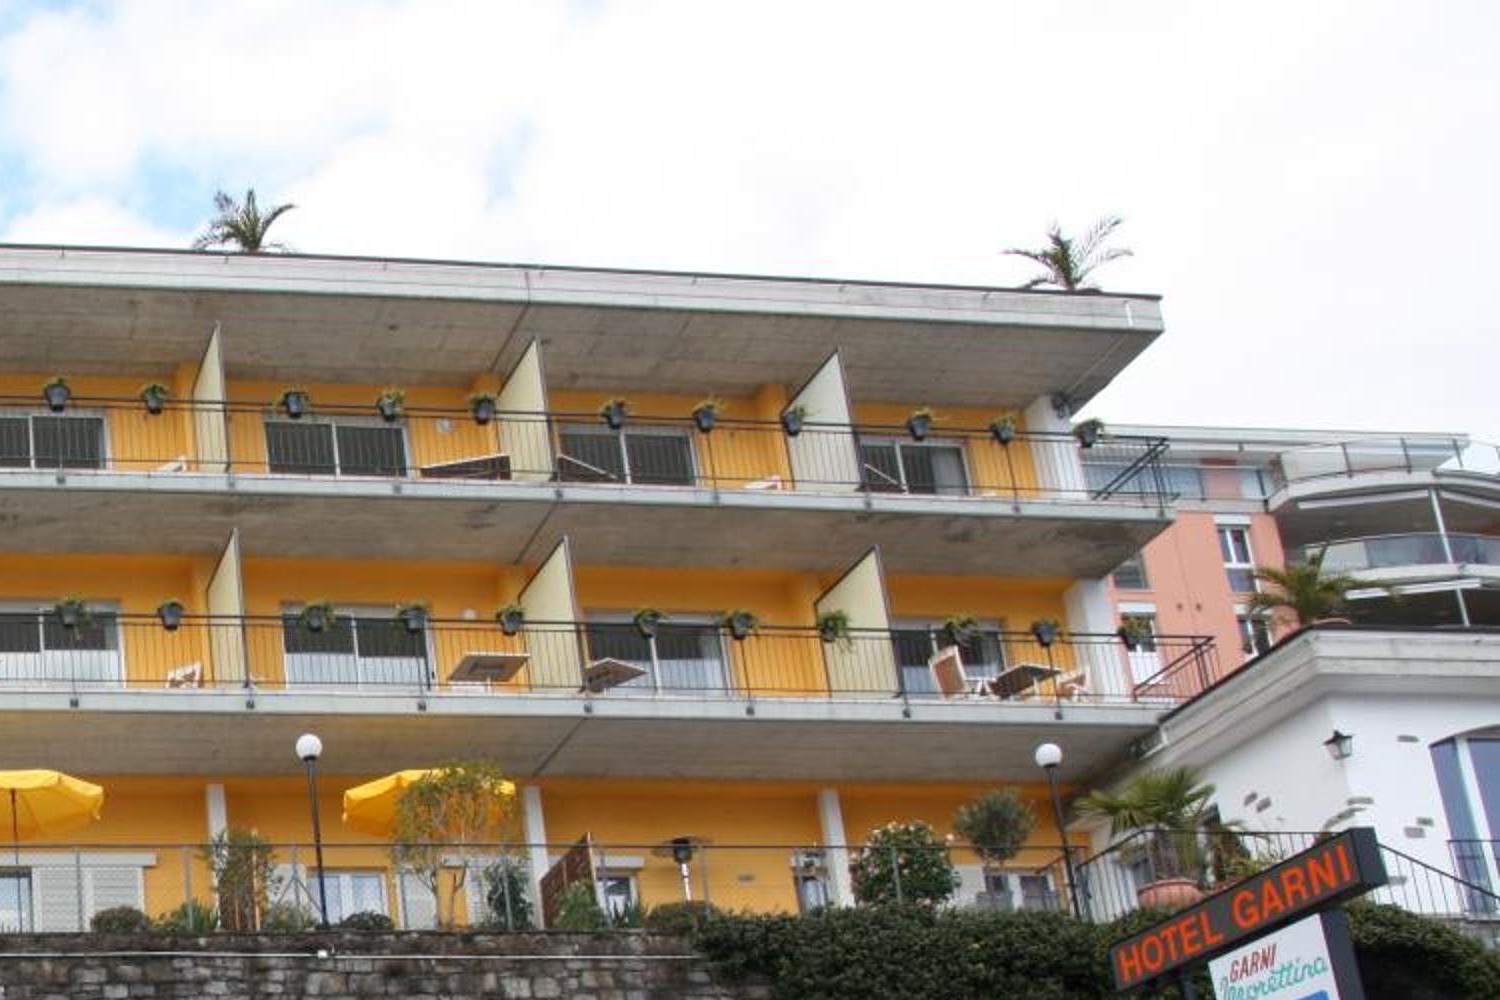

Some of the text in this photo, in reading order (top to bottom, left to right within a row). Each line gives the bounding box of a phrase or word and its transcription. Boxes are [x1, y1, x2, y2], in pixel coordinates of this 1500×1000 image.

[1116, 842, 1352, 983] HOTEL GARNI
[1229, 944, 1278, 982] GARNI
